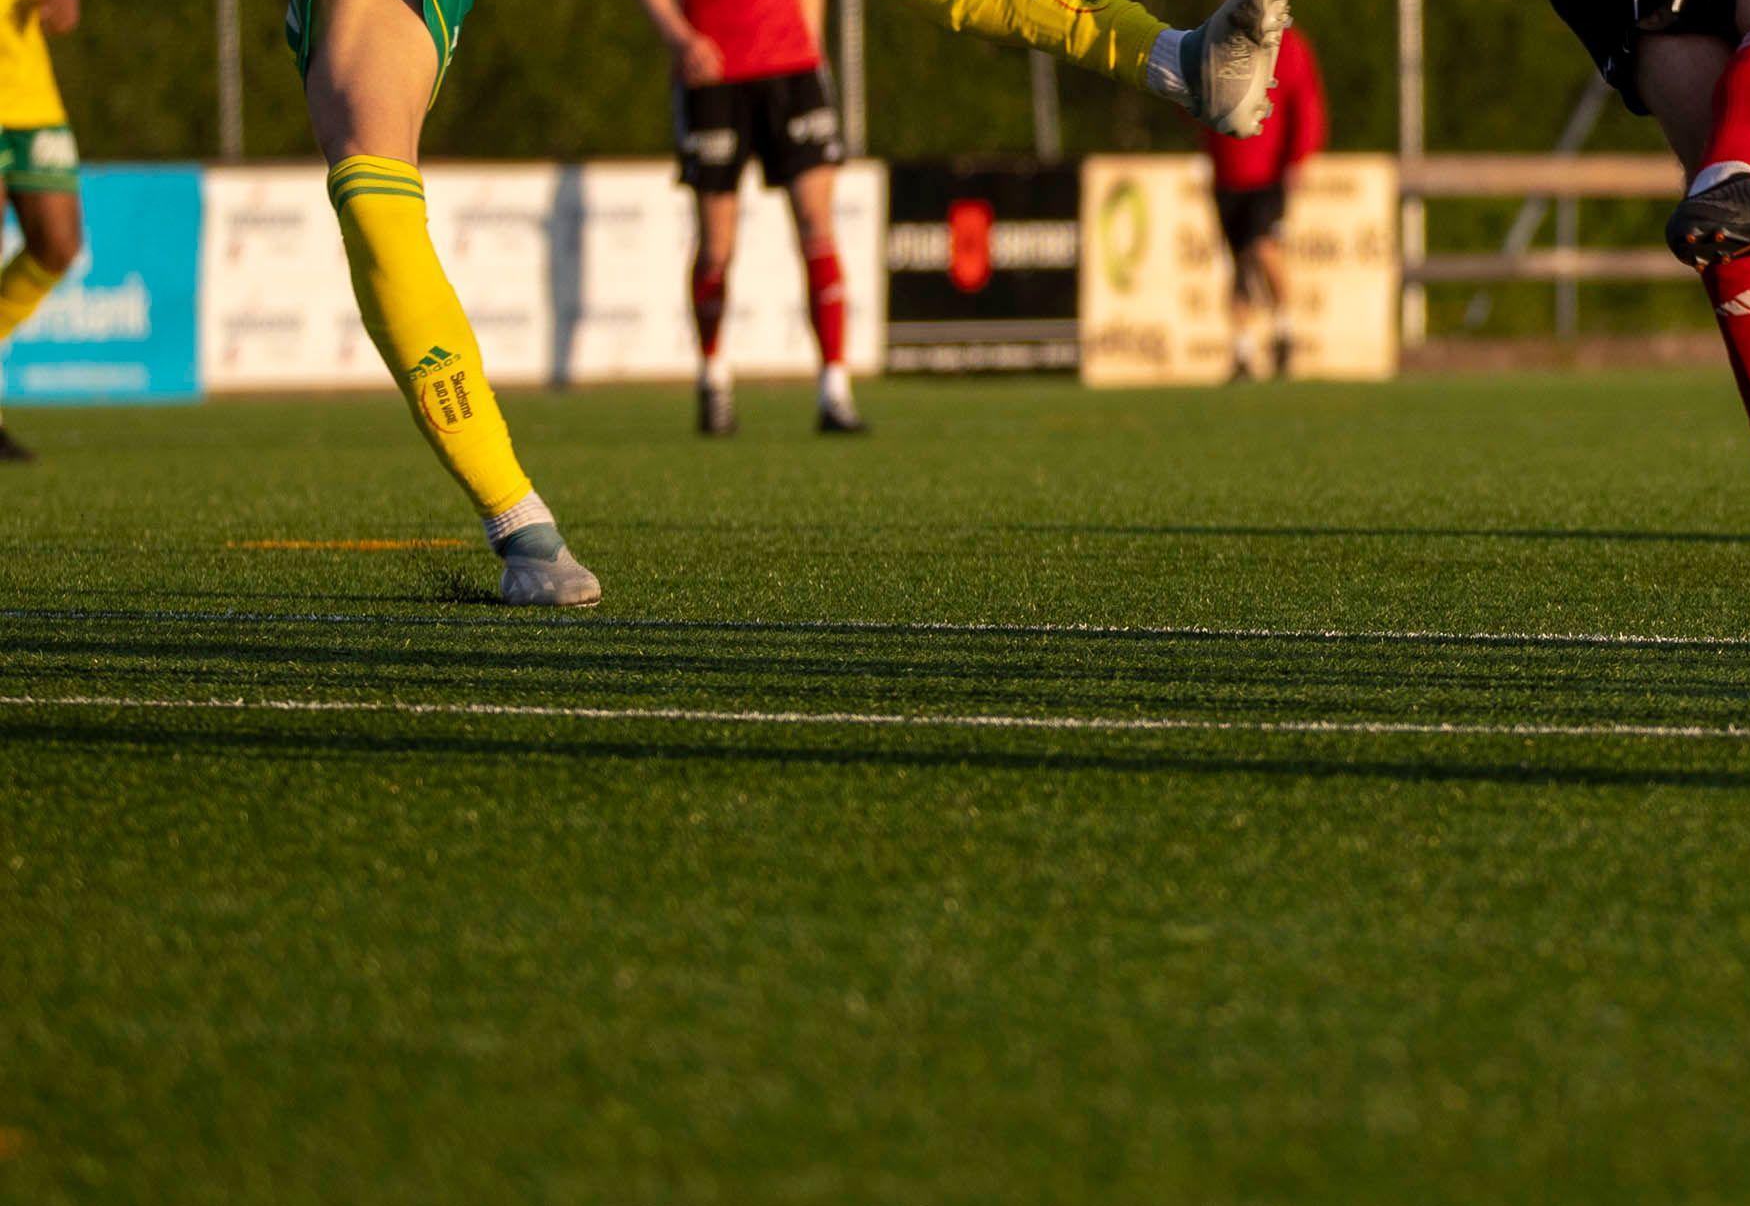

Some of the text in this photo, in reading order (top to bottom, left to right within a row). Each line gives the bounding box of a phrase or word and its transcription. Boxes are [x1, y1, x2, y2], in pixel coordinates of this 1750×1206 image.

[432, 380, 449, 399] BUD
[441, 404, 459, 426] VARE
[450, 370, 474, 420] Skedsmo
